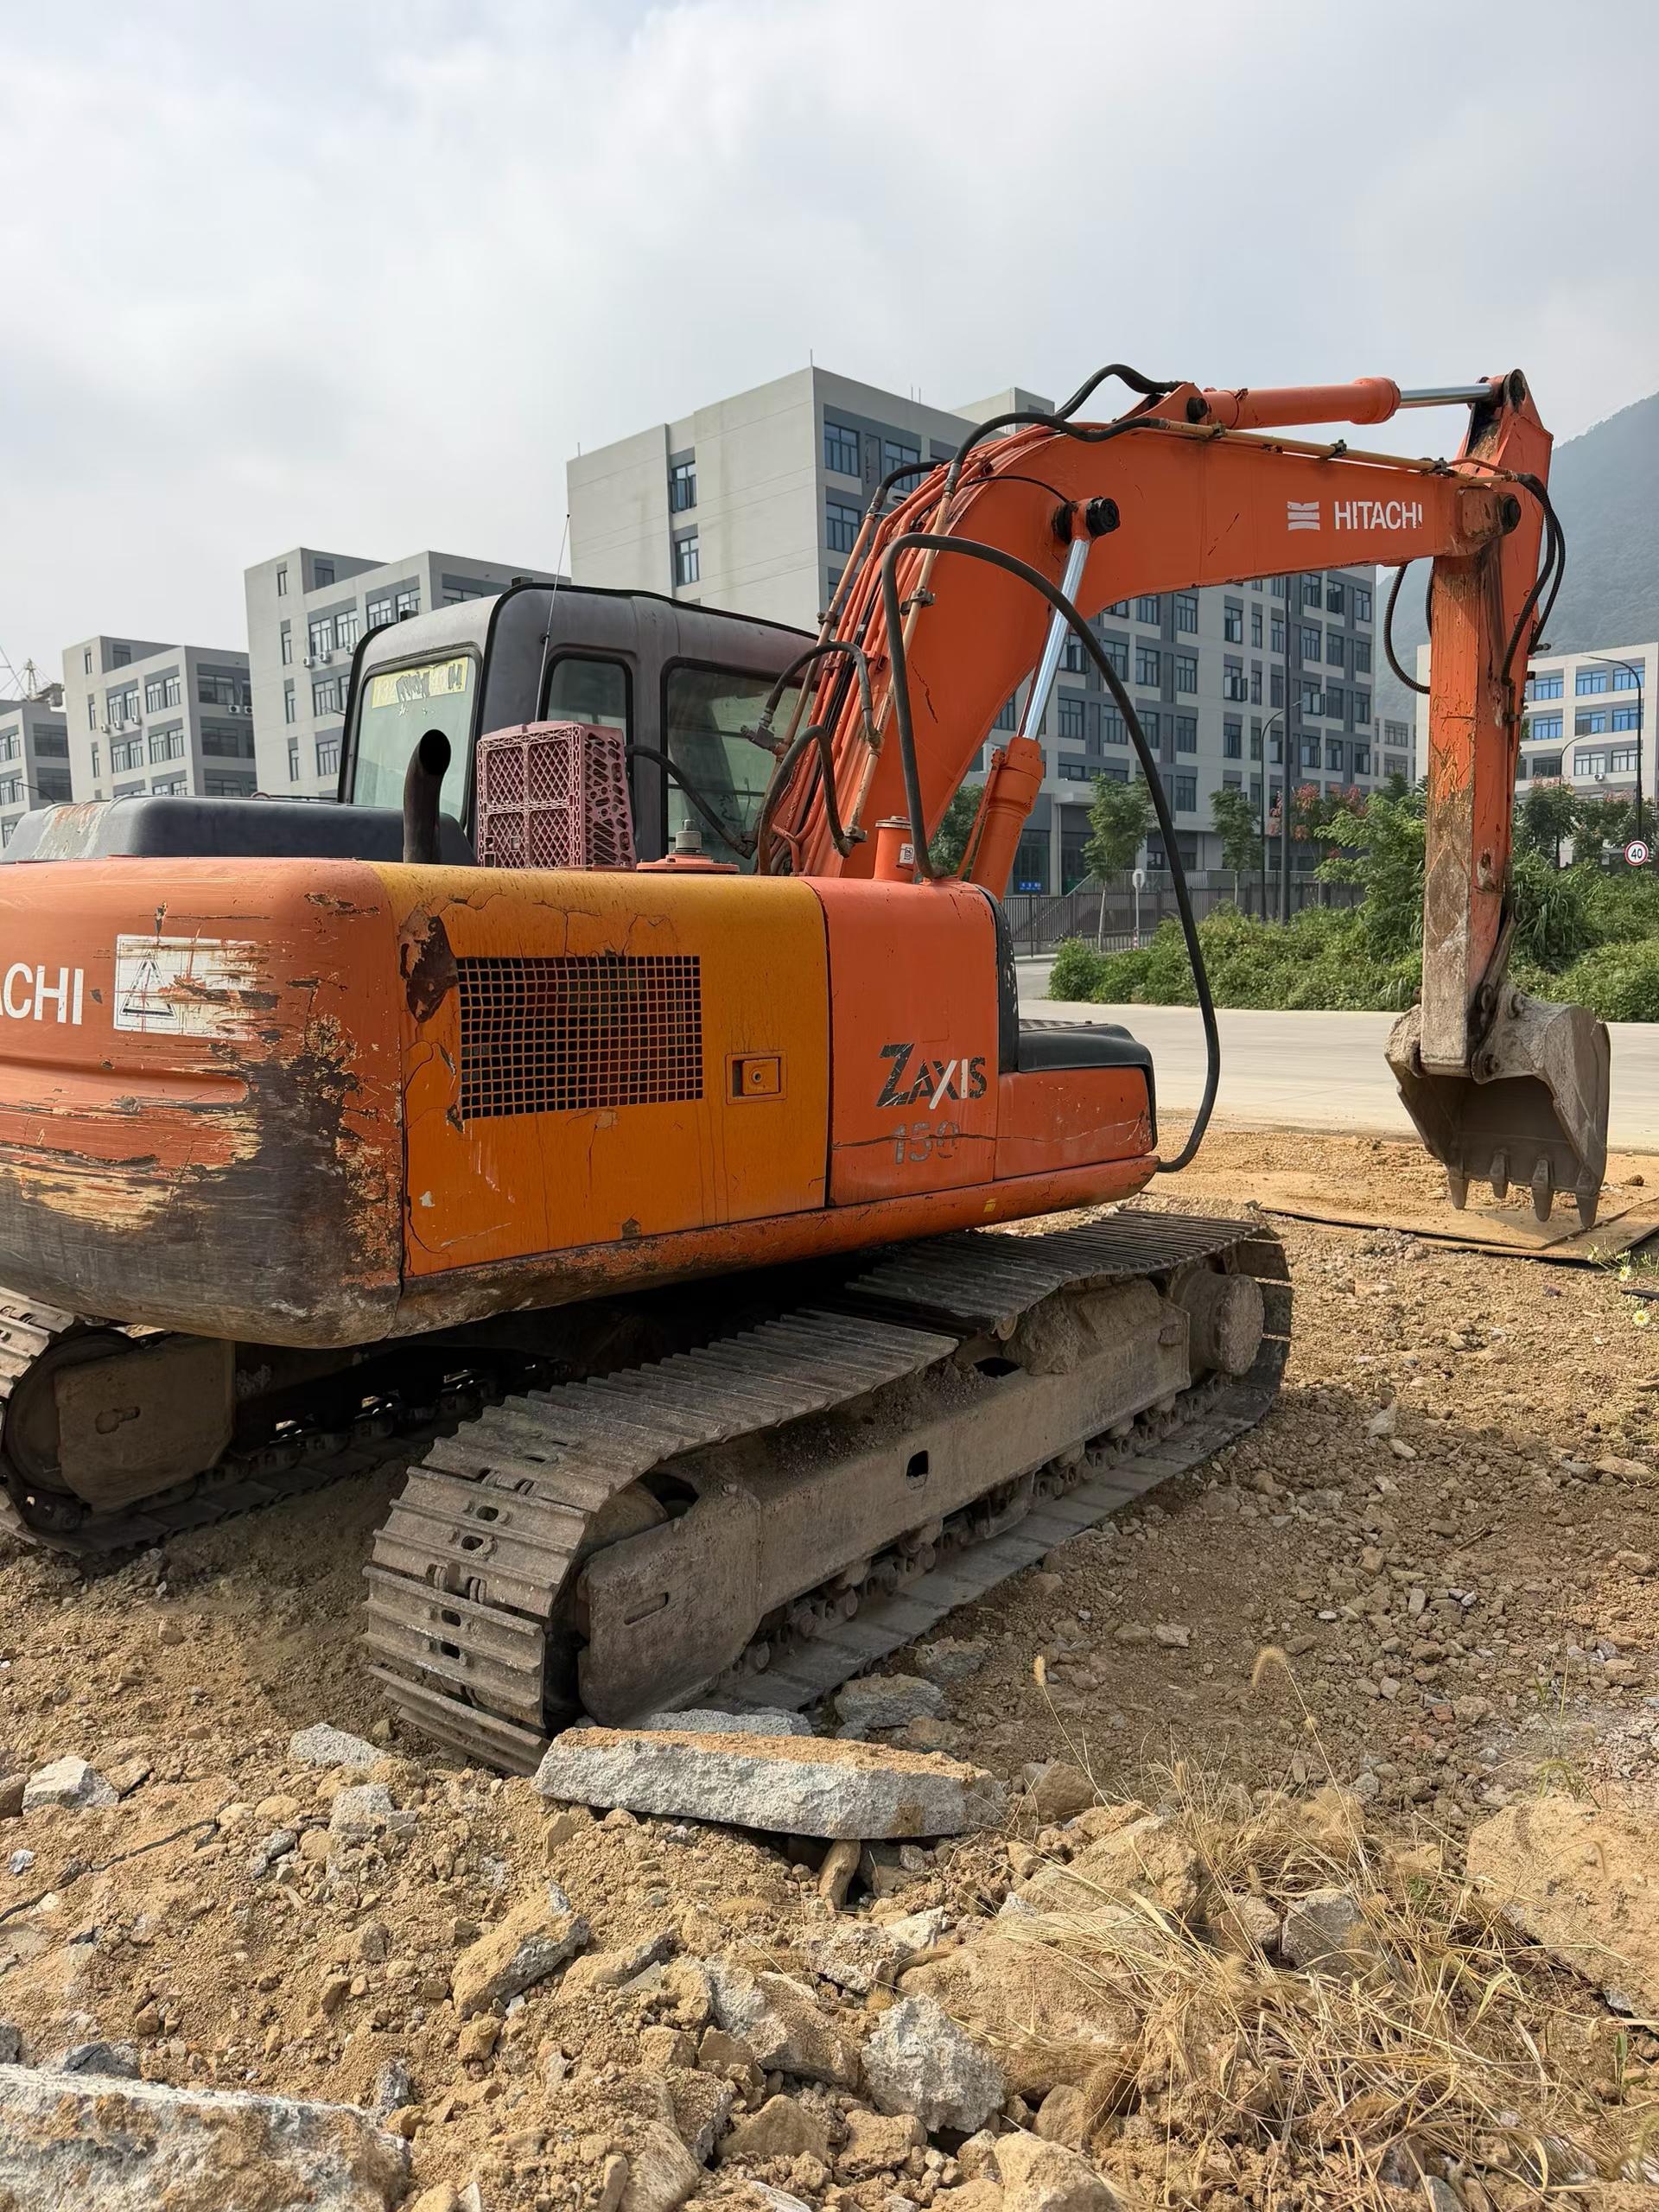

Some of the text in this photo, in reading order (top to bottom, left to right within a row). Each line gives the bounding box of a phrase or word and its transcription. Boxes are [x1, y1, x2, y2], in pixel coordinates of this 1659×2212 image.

[1334, 500, 1423, 530] HITACHI
[1630, 848, 1643, 860] 40
[0, 963, 84, 1026] CHI
[876, 1043, 988, 1110] ZAXIS
